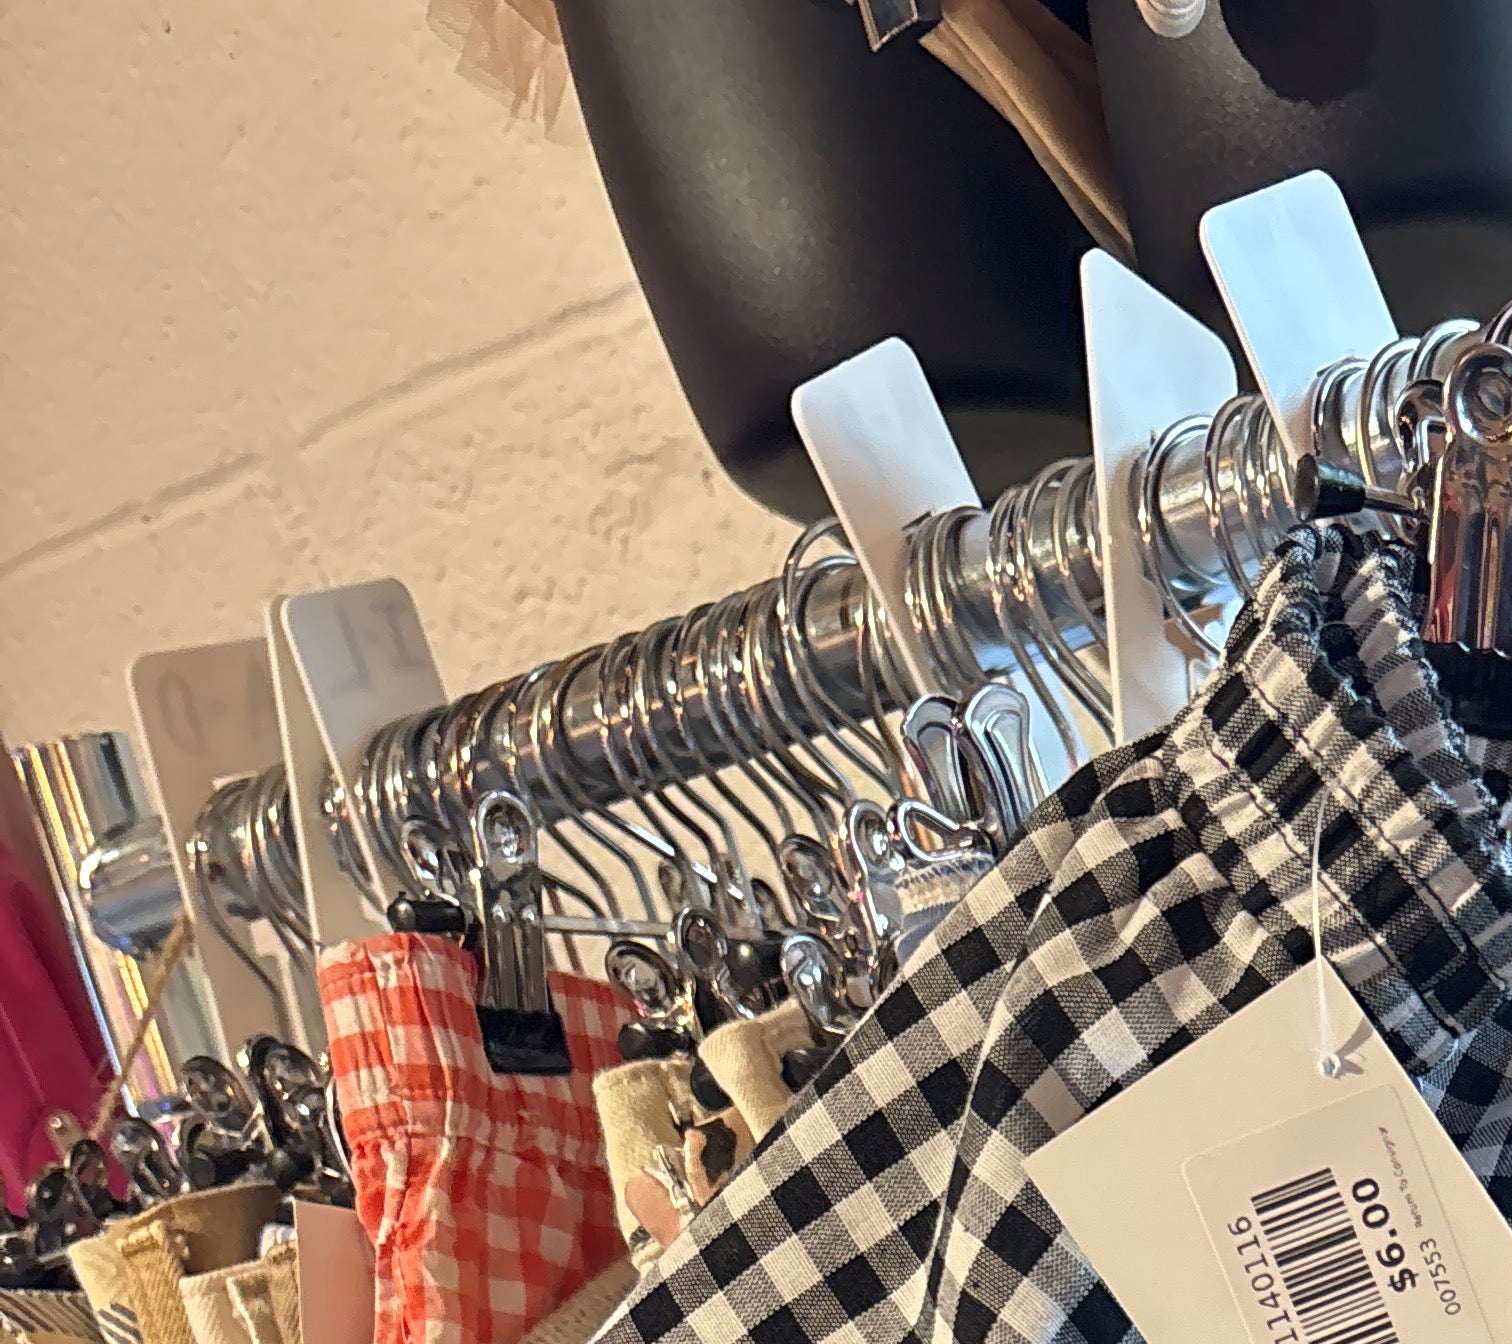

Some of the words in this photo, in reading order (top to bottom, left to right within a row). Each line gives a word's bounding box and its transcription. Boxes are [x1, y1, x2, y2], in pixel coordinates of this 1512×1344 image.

[1399, 1178, 1409, 1193] To
[1404, 1193, 1423, 1229] Return
[1351, 1177, 1420, 1293] $6.00
[1419, 1237, 1462, 1316] 007553
